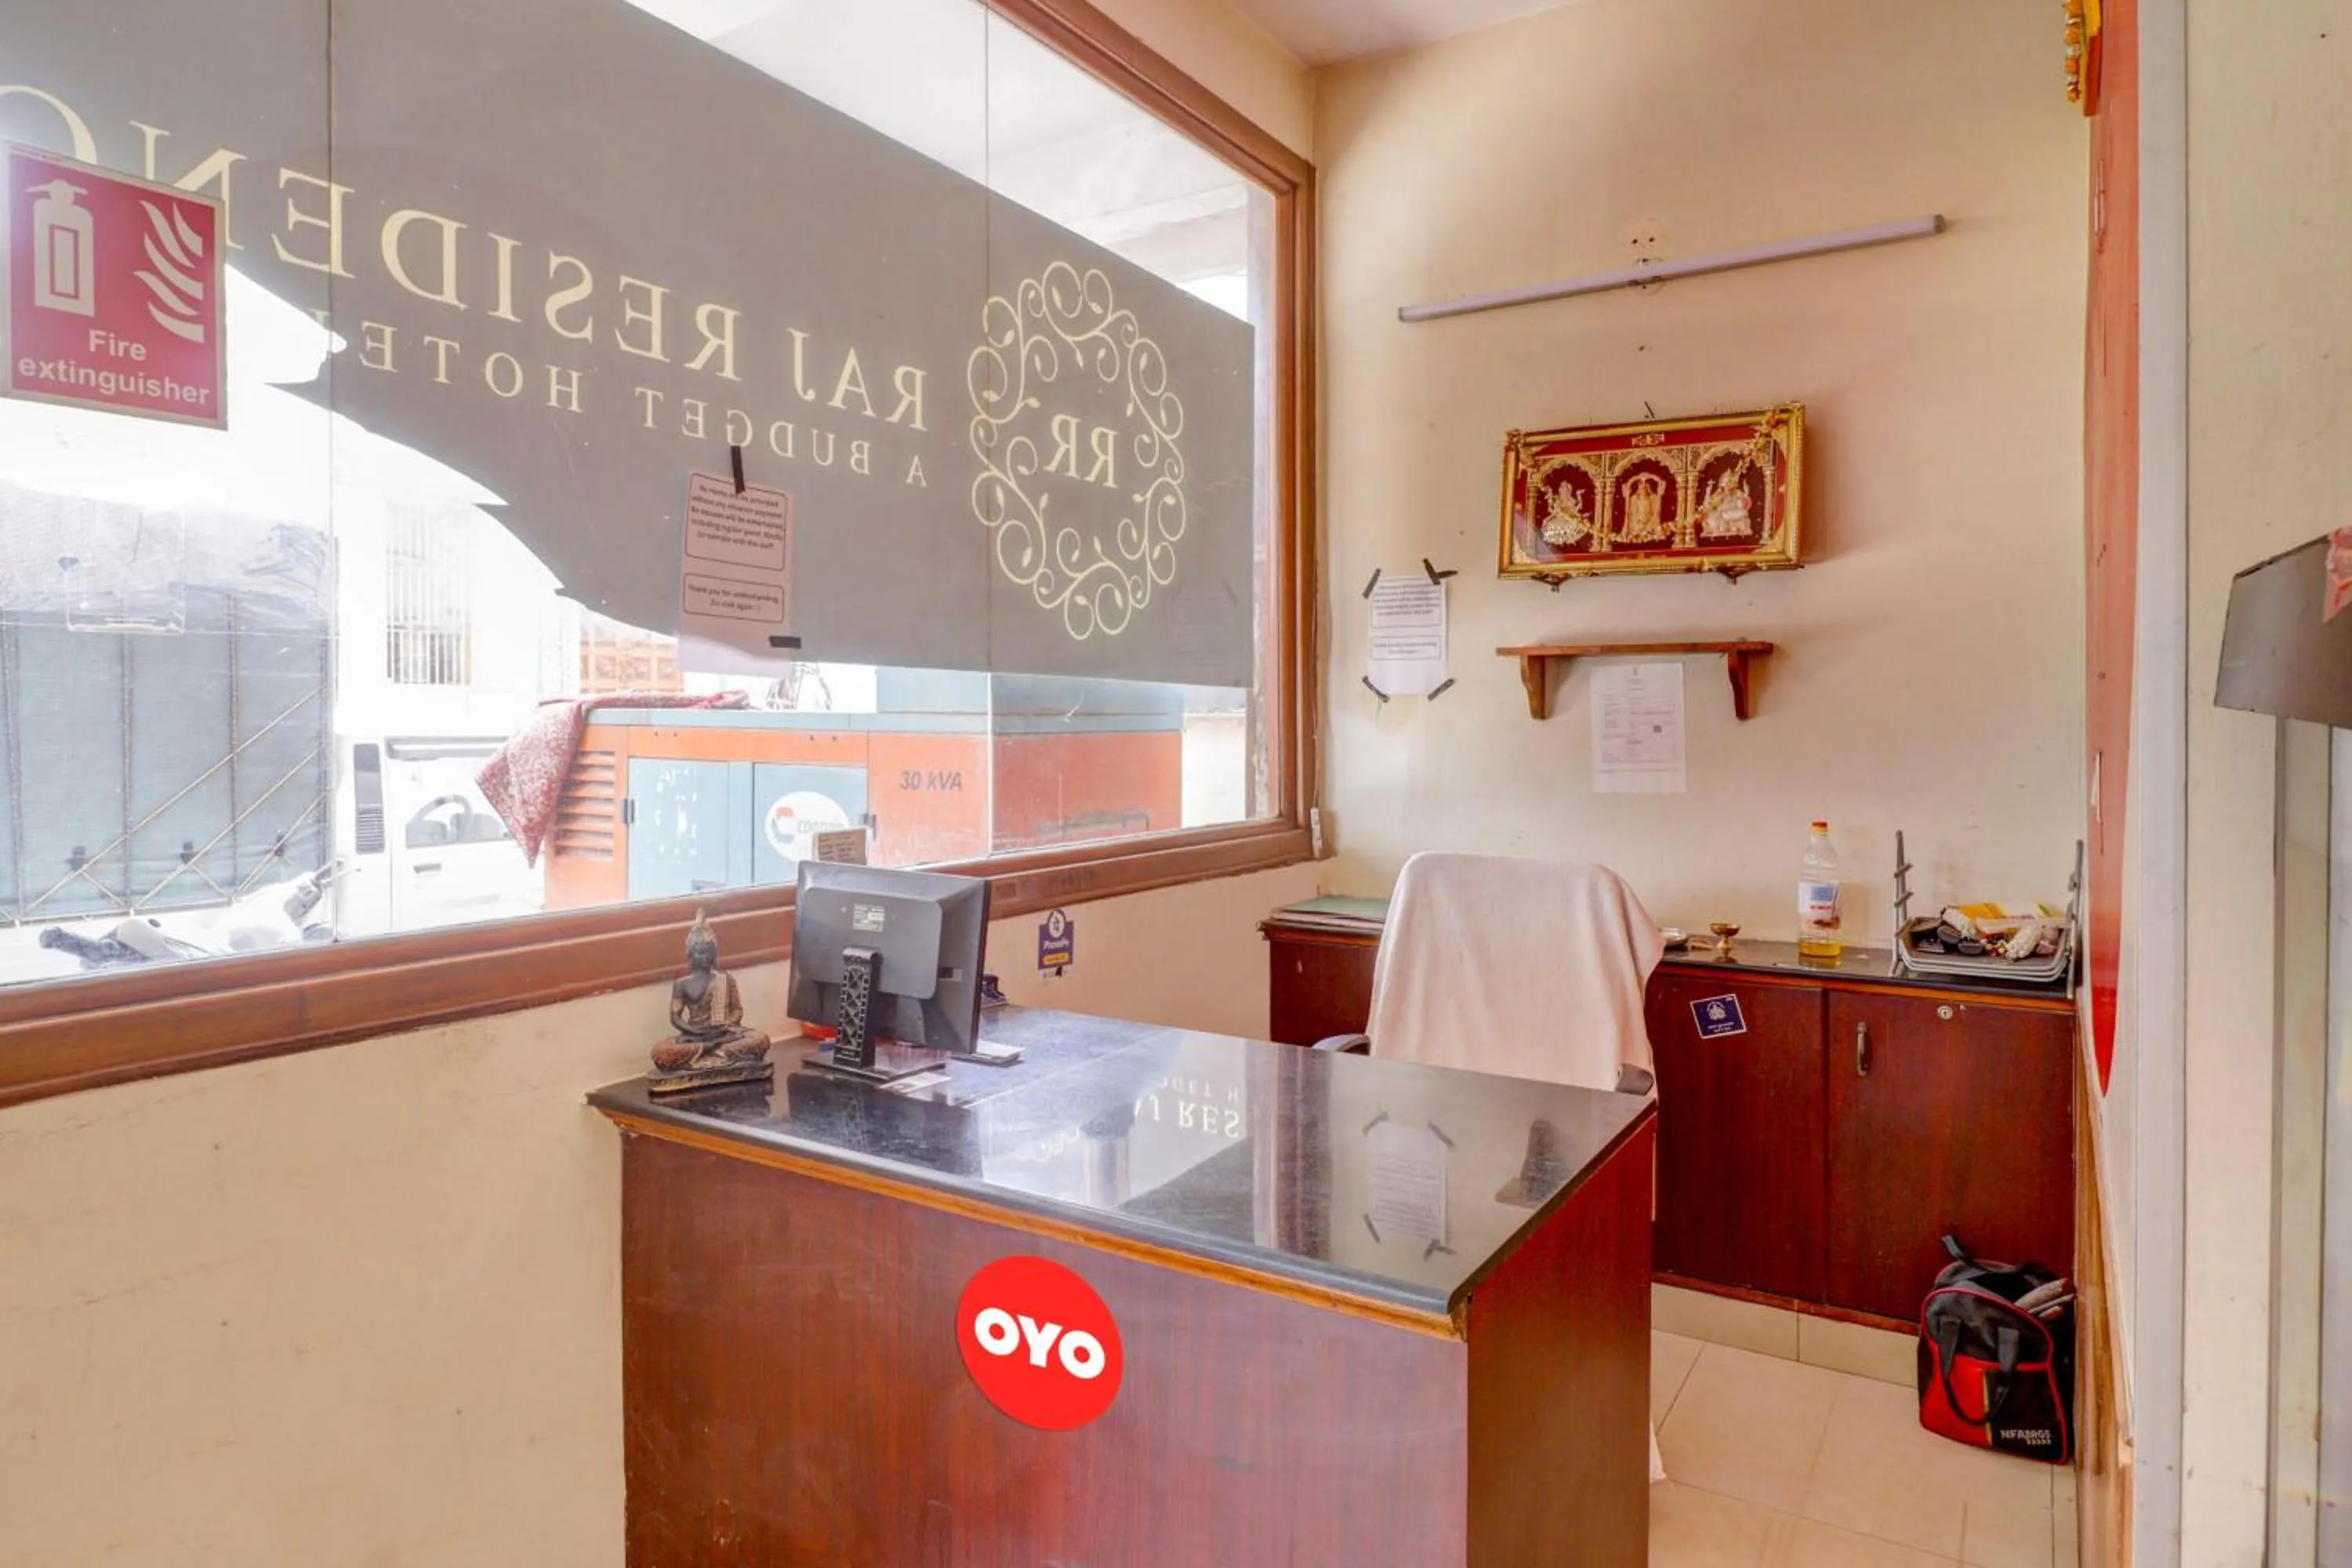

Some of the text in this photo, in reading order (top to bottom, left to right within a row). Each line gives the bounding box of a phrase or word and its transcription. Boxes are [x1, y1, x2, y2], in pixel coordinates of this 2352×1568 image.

[88, 328, 147, 361] Fire
[19, 357, 210, 406] extinguisher
[900, 771, 964, 791] 30 kVA
[974, 1306, 1105, 1379] OYO
